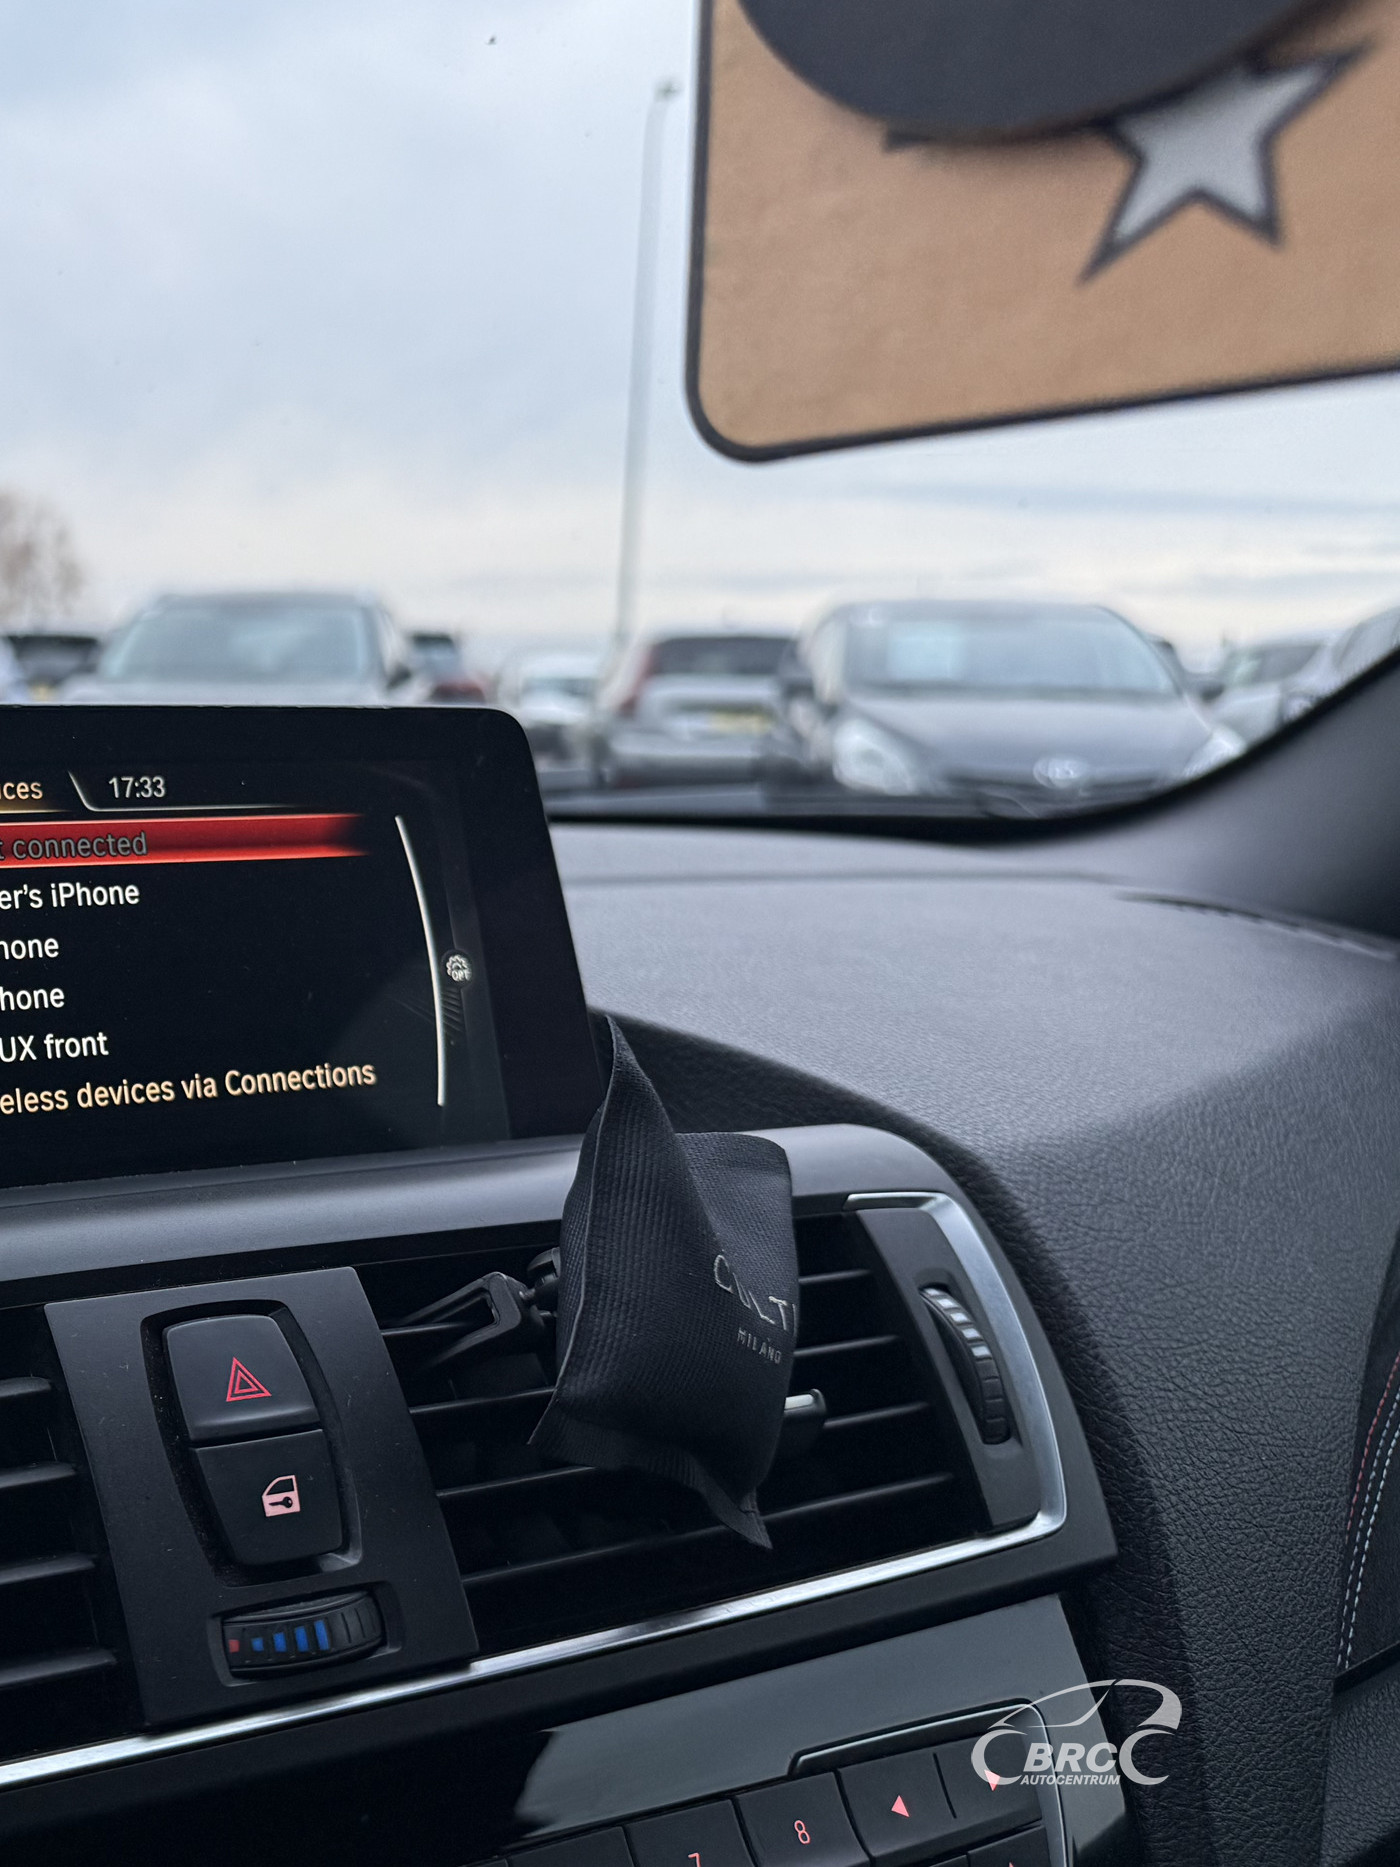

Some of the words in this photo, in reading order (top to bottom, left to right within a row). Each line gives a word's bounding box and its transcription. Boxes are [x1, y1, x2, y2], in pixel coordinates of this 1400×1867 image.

[108, 776, 166, 798] 17:33
[12, 831, 148, 860] connected
[50, 882, 141, 908] iPhone
[43, 1031, 109, 1059] front
[76, 1076, 175, 1109] devices
[181, 1073, 218, 1100] via
[225, 1062, 376, 1096] Connections
[737, 1327, 782, 1364] MILANO
[794, 1819, 811, 1844] 8
